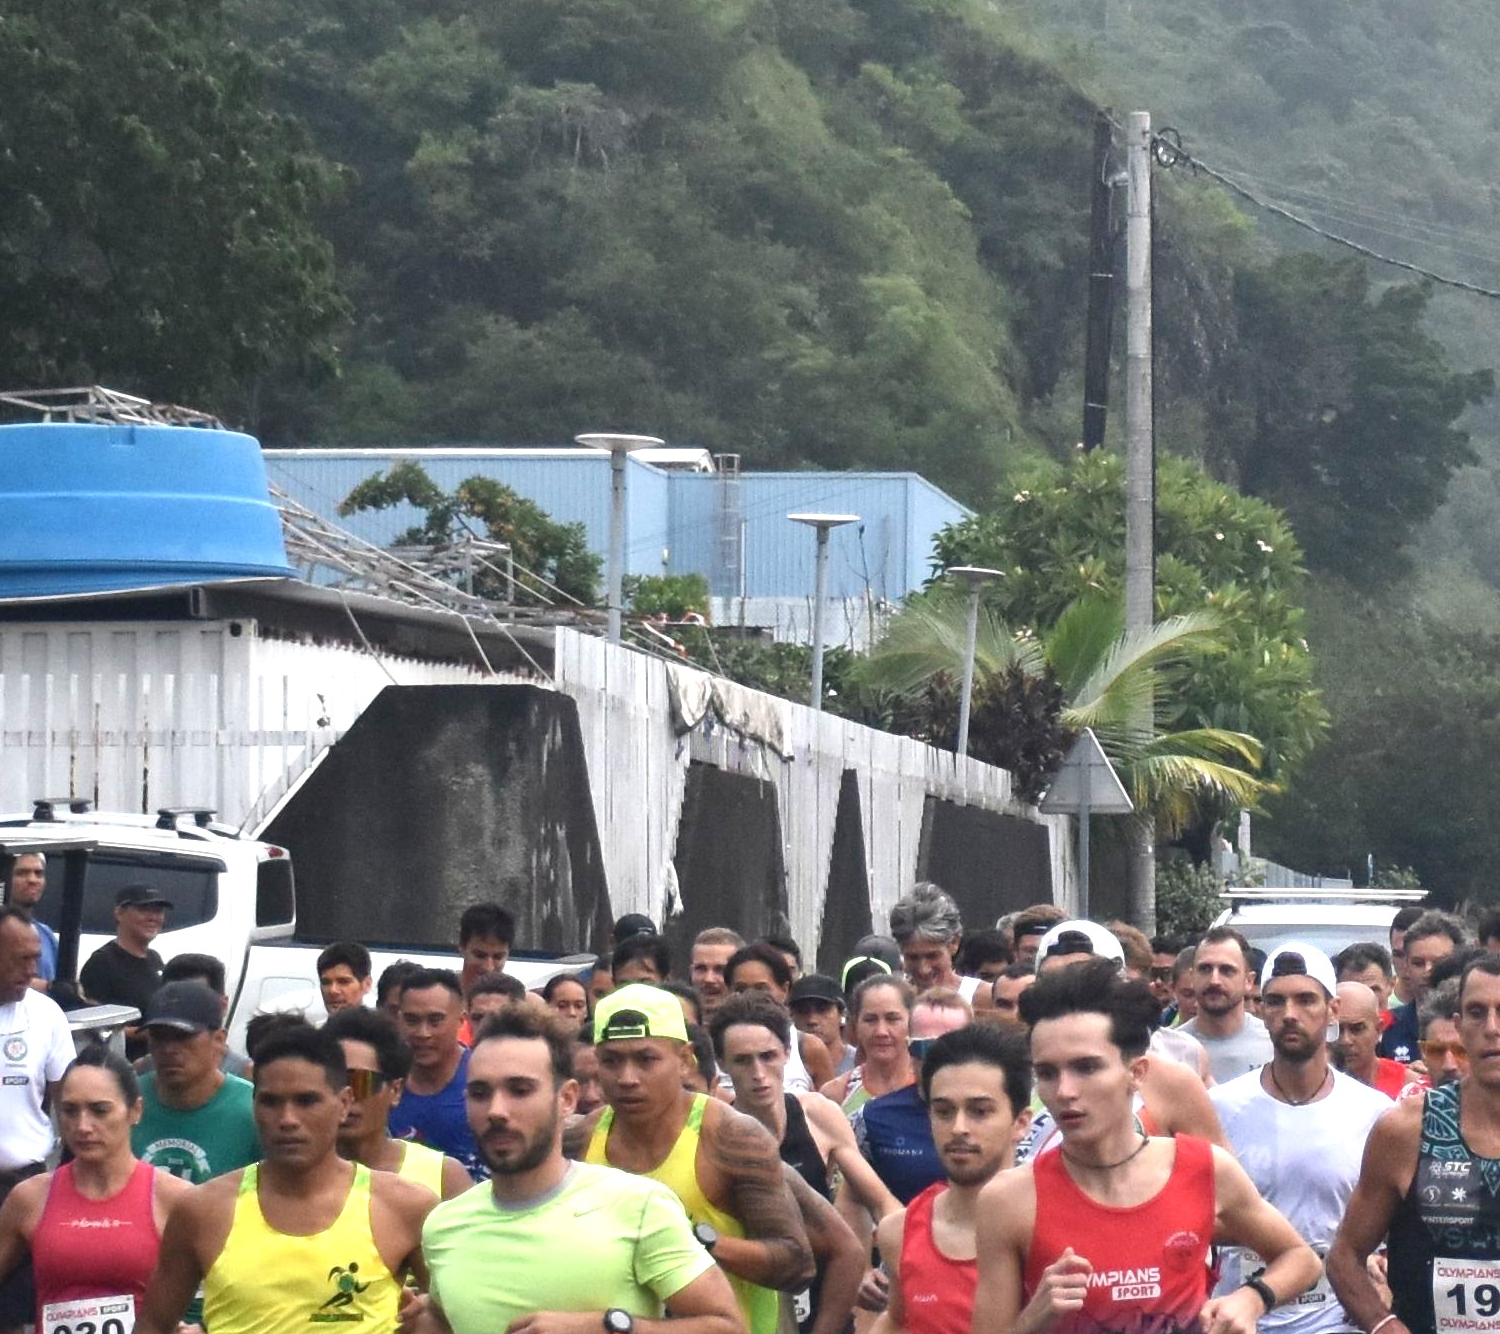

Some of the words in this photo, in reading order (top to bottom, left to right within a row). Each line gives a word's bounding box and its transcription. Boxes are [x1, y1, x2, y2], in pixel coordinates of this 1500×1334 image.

[1086, 1267, 1161, 1288] YMPIANS
[1116, 1285, 1155, 1297] SPORT
[46, 1306, 98, 1321] OLYMPIANS
[101, 1304, 127, 1315] SPORT
